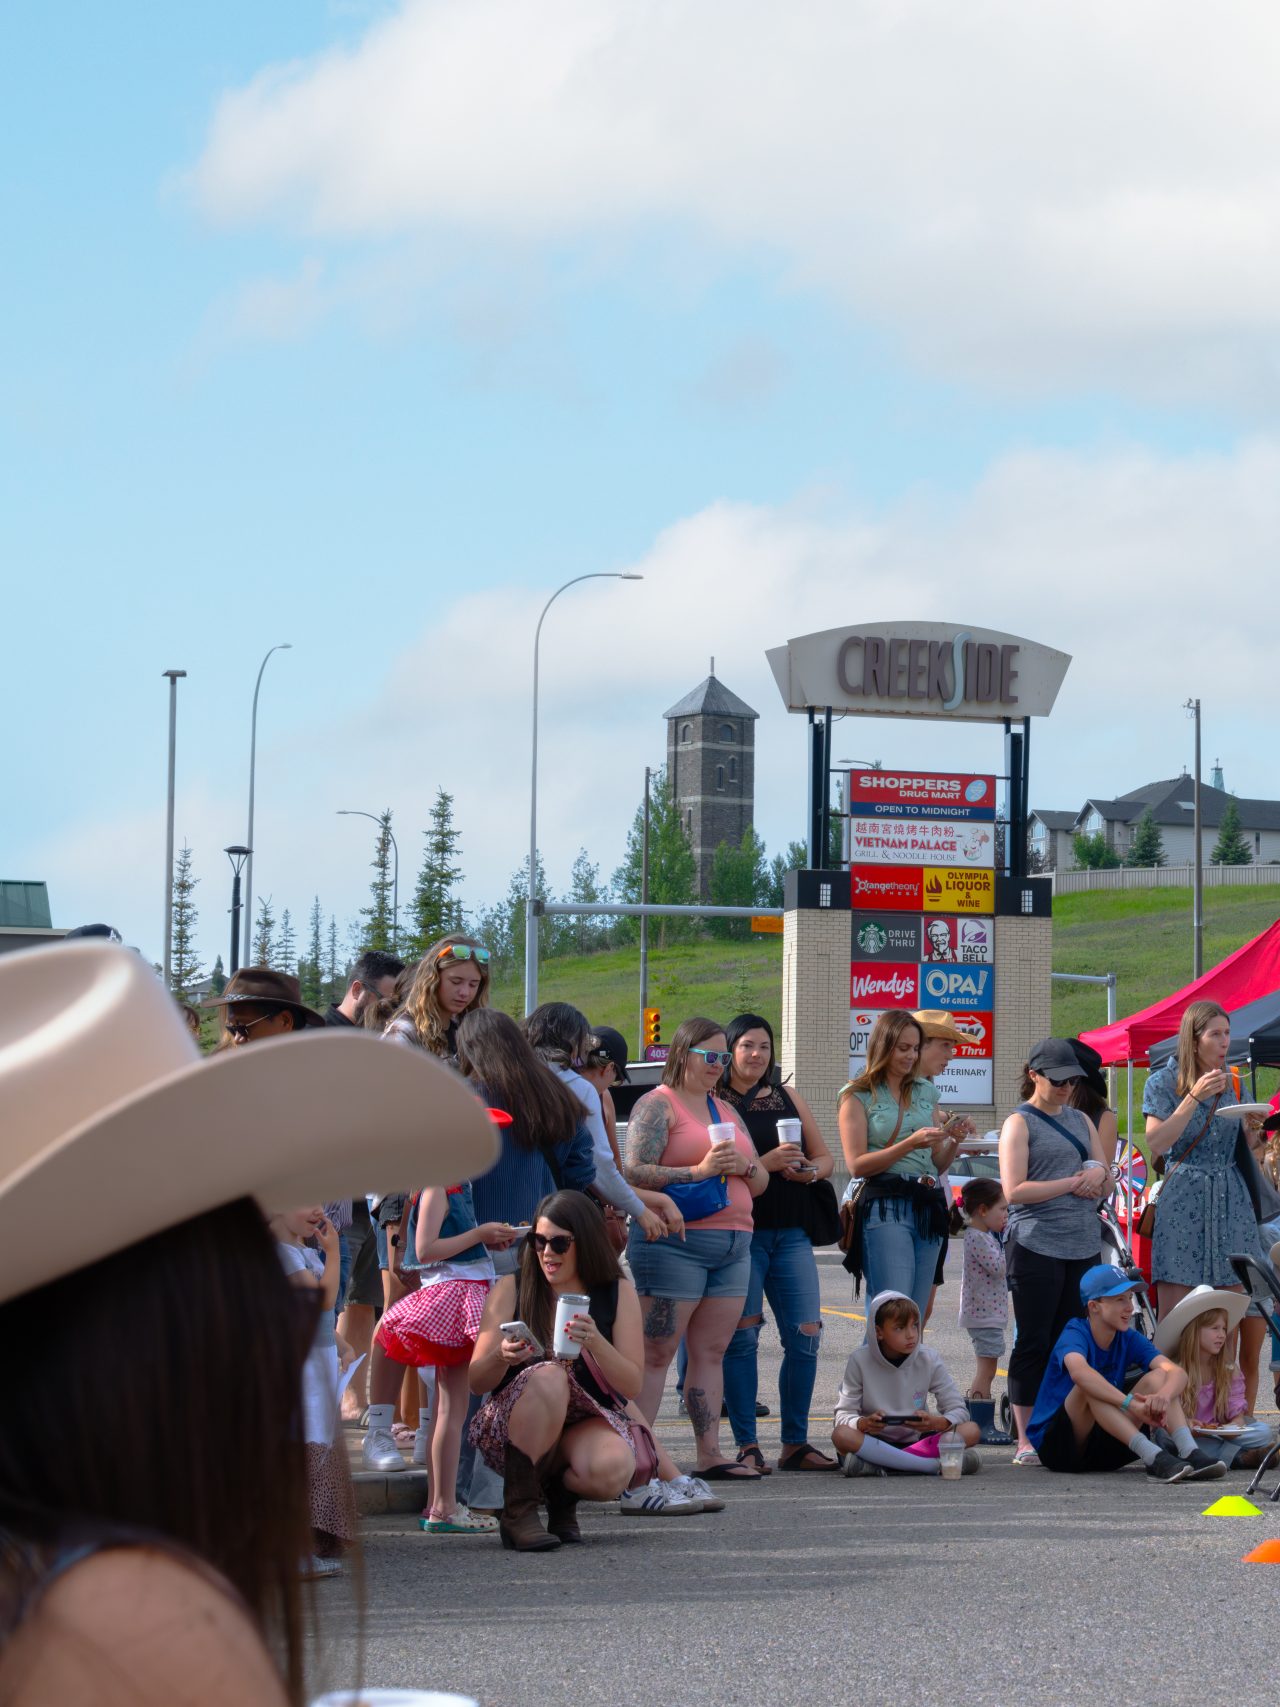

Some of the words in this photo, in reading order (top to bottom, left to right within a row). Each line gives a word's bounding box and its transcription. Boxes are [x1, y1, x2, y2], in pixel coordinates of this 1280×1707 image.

[837, 632, 1019, 711] CREEKSIDE
[859, 776, 961, 791] SHOPPERS
[899, 790, 928, 798] DRUG
[875, 805, 903, 814] OPEN
[905, 806, 919, 814] TO
[921, 807, 970, 816] MIDNIGHT
[854, 837, 908, 849] VIETNAM
[911, 839, 957, 851] PALACE
[855, 849, 878, 858] GRILL
[882, 850, 891, 860] &
[893, 852, 928, 860] NOODLE
[930, 853, 957, 861] HOUSE
[947, 872, 989, 880] OLYMPIA
[946, 881, 990, 891] LIQUOR
[965, 891, 971, 899] &
[888, 930, 916, 938] DRIVE
[890, 939, 915, 948] THRU
[961, 945, 988, 954] TACO
[962, 954, 987, 963] BELL
[852, 972, 915, 999] Wendy's
[926, 969, 988, 997] OPA!
[849, 1032, 870, 1051] OPT
[650, 1049, 669, 1058] 403-
[961, 1046, 986, 1056] Thru
[941, 1068, 987, 1077] ETERINARY
[935, 1085, 958, 1093] PITAL
